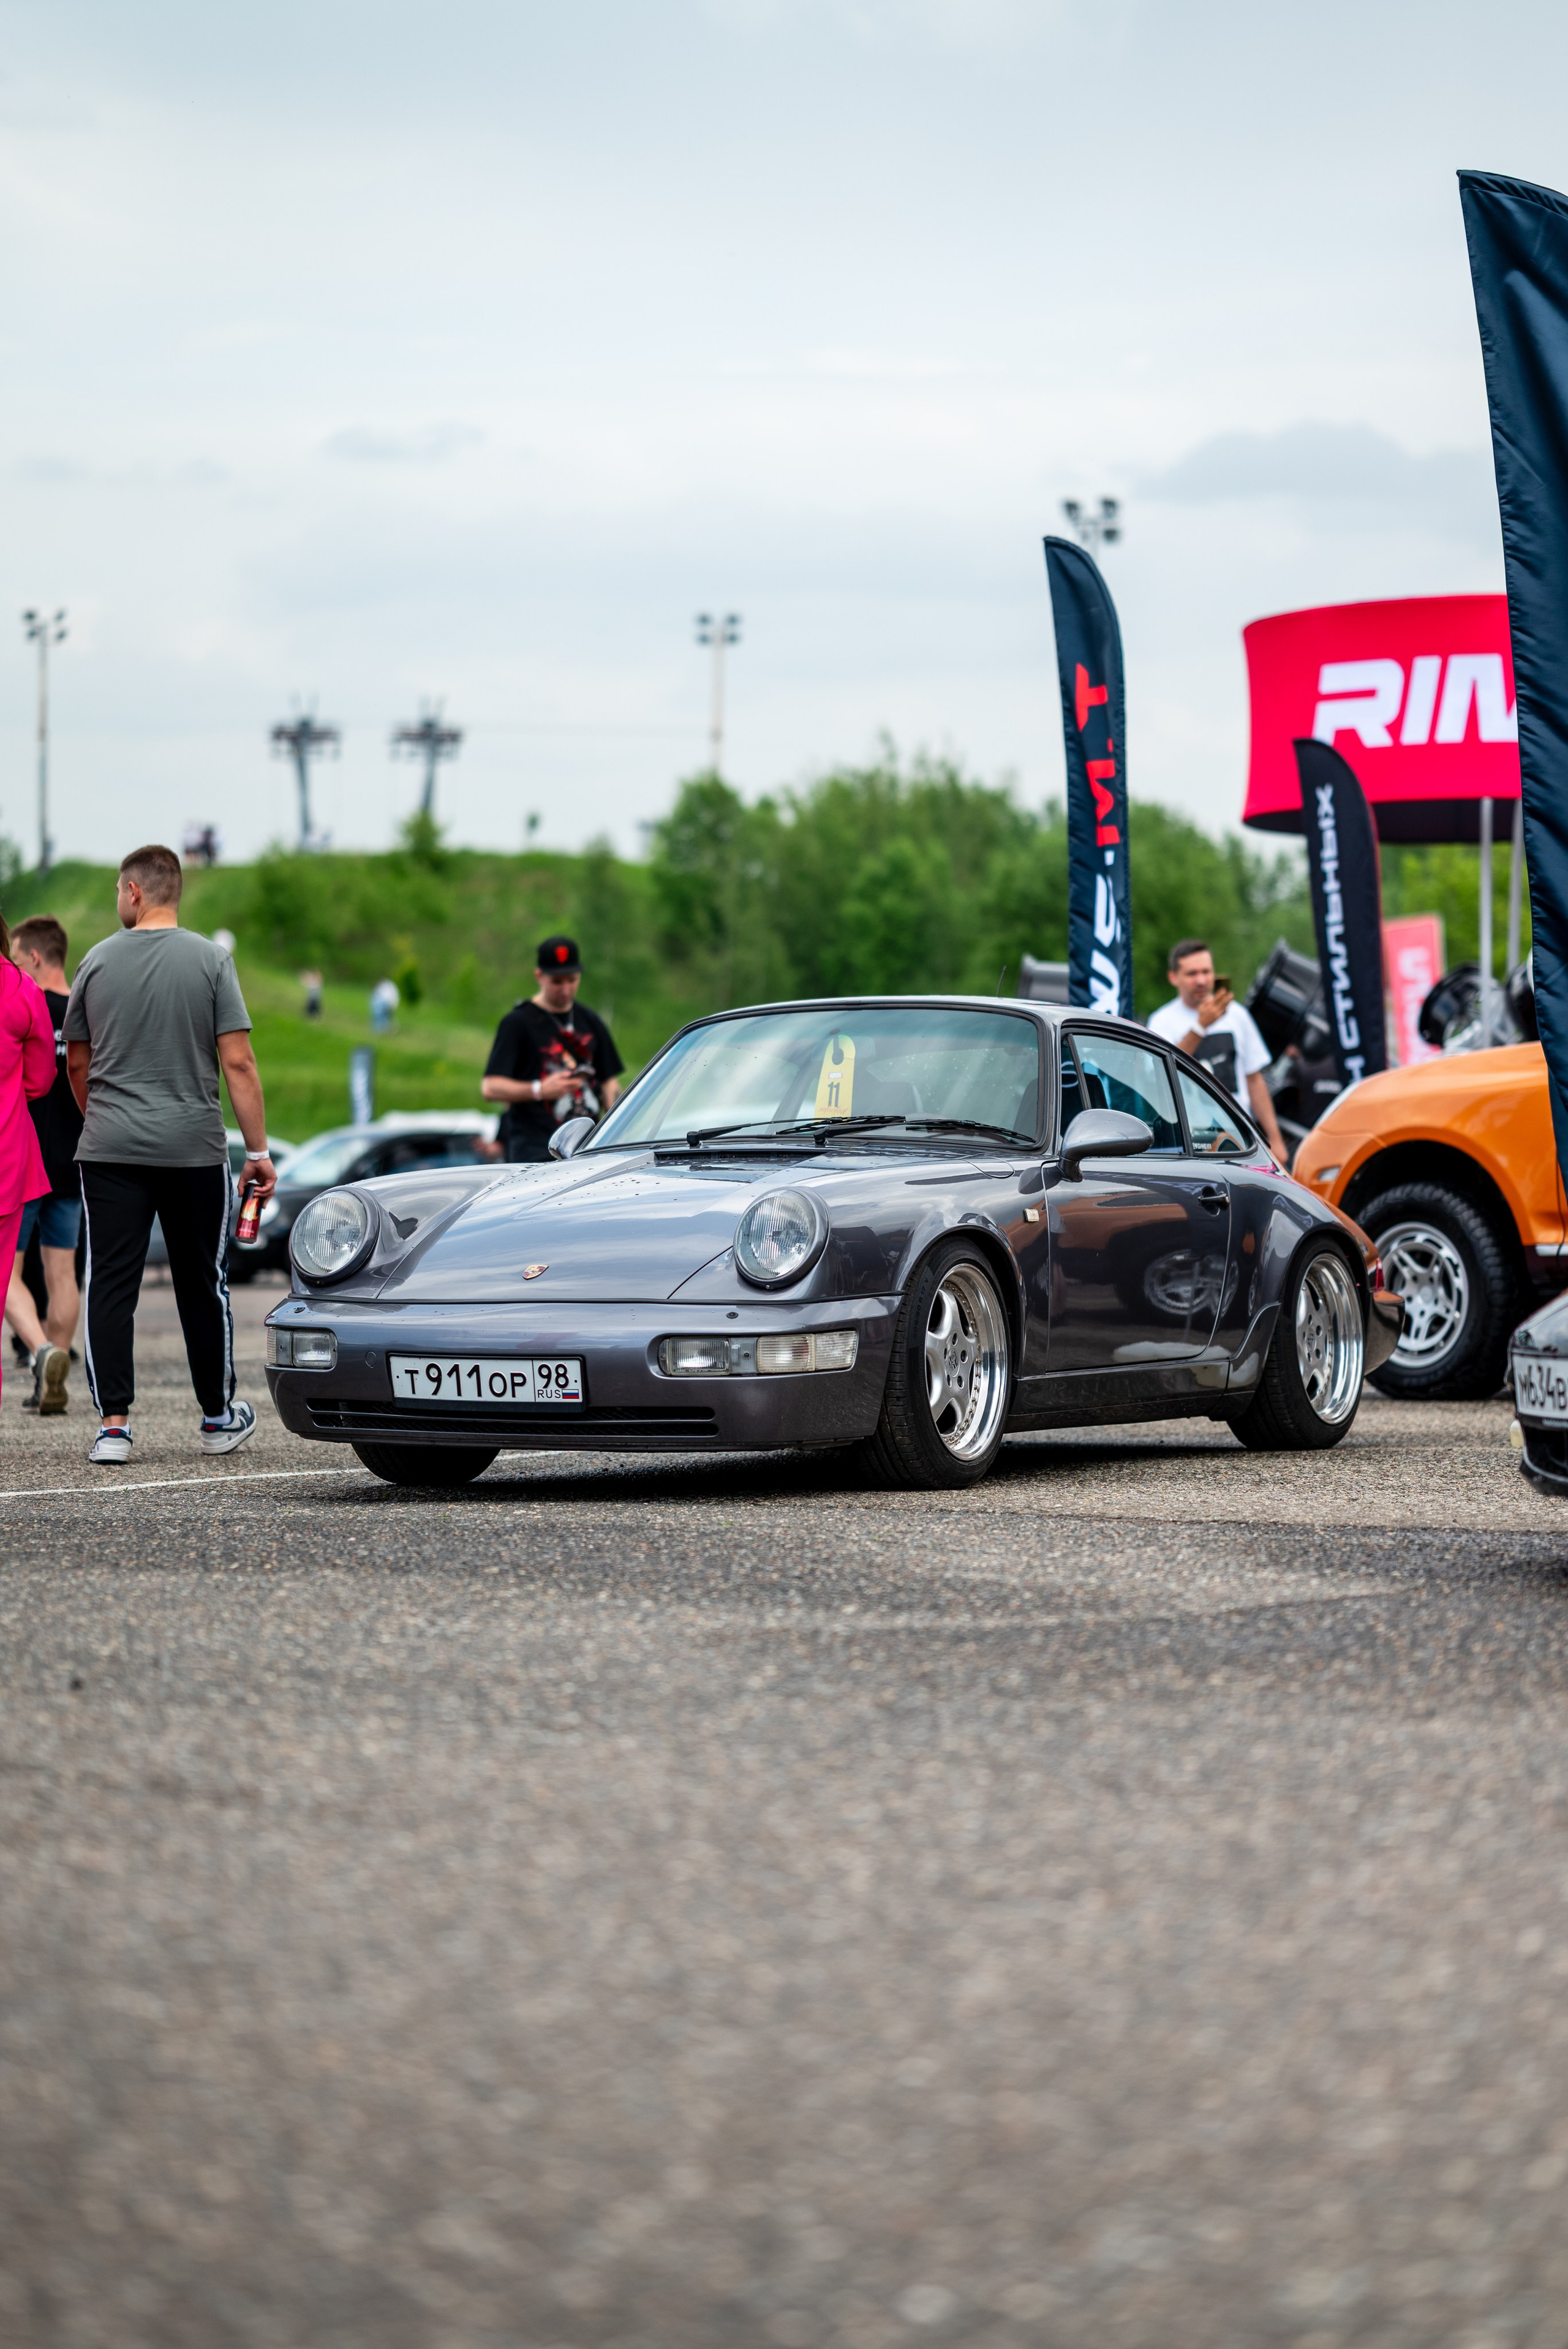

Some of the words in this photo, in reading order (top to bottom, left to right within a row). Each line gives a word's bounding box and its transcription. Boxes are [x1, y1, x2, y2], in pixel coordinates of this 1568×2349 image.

[1316, 782, 1361, 1050] СТИЛЬНЫХ
[827, 1081, 840, 1108] 11
[404, 1362, 527, 1398] Т911ОР
[538, 1363, 570, 1389] 98
[537, 1389, 561, 1398] RUS
